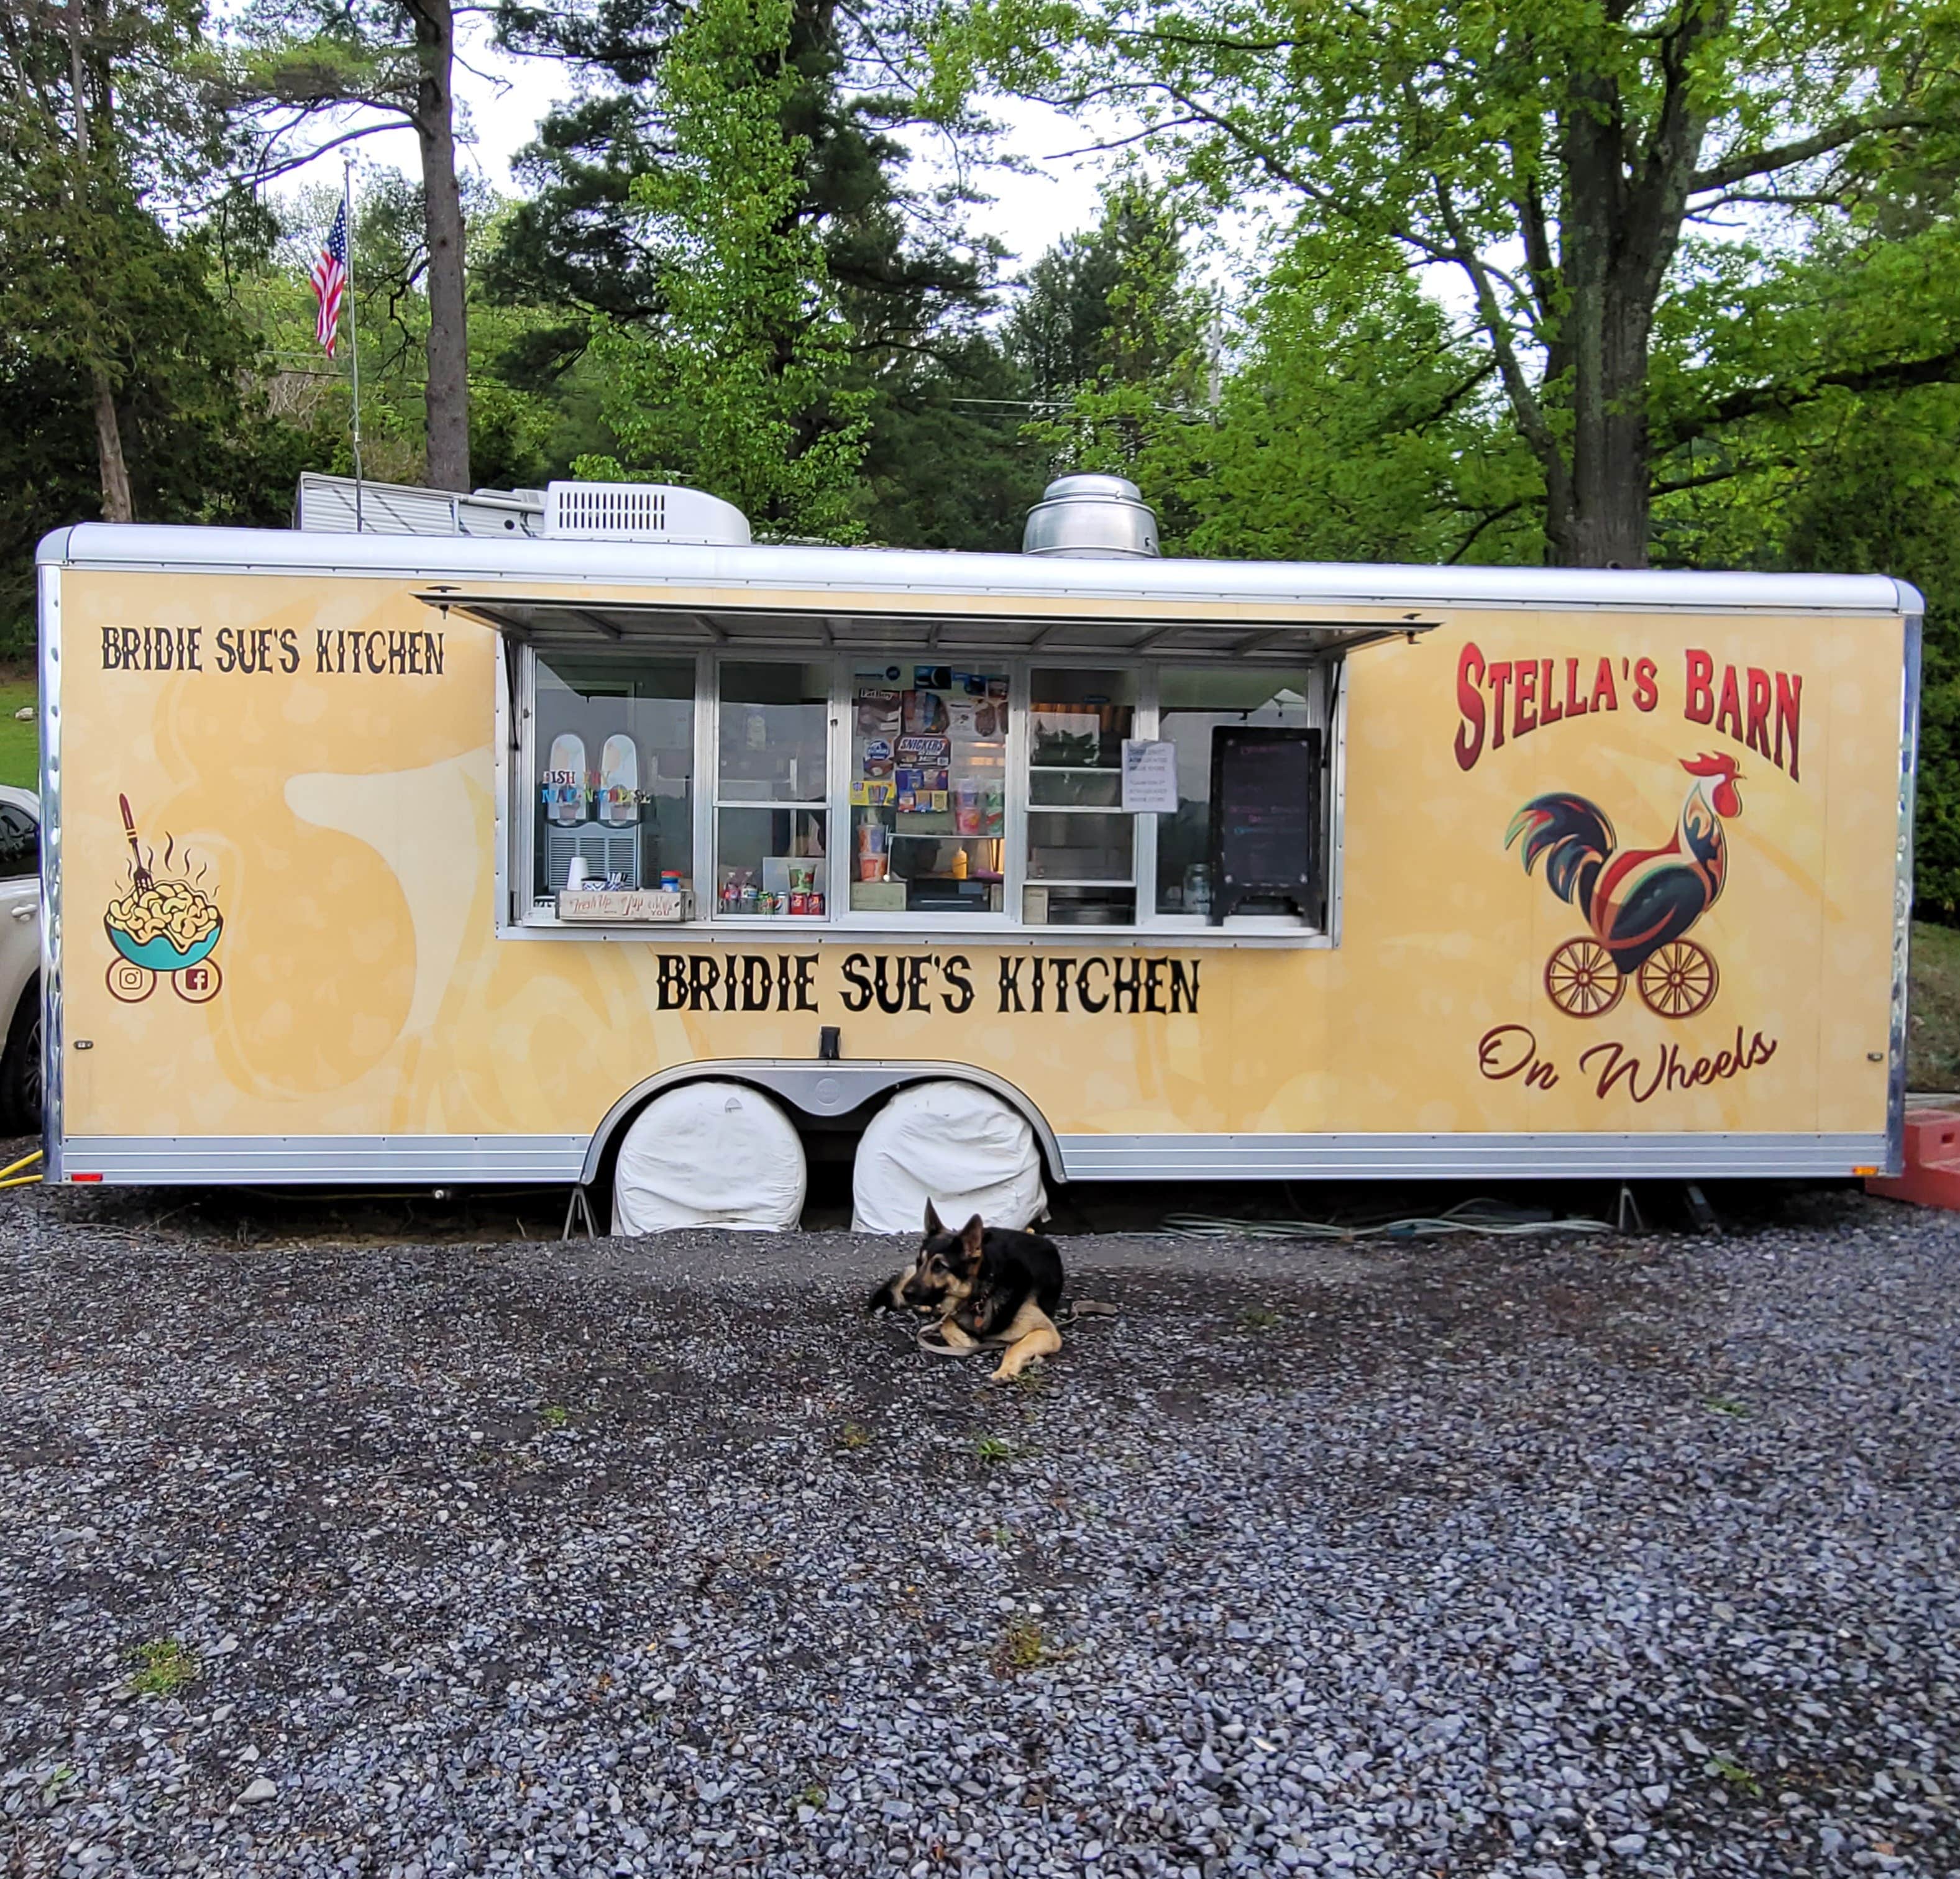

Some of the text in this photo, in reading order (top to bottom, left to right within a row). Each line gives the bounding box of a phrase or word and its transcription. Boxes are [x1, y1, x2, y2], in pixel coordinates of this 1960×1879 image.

[101, 626, 444, 675] BRIDIE SUE'S KITCHEN
[1454, 642, 1803, 783] STELLA'S BARN
[900, 738, 943, 751] SNICKERS
[543, 770, 575, 785] FISH
[654, 952, 1202, 1016] BRIDIE SUE'S KITCHEN
[1478, 1024, 1778, 1103] On Wheels
